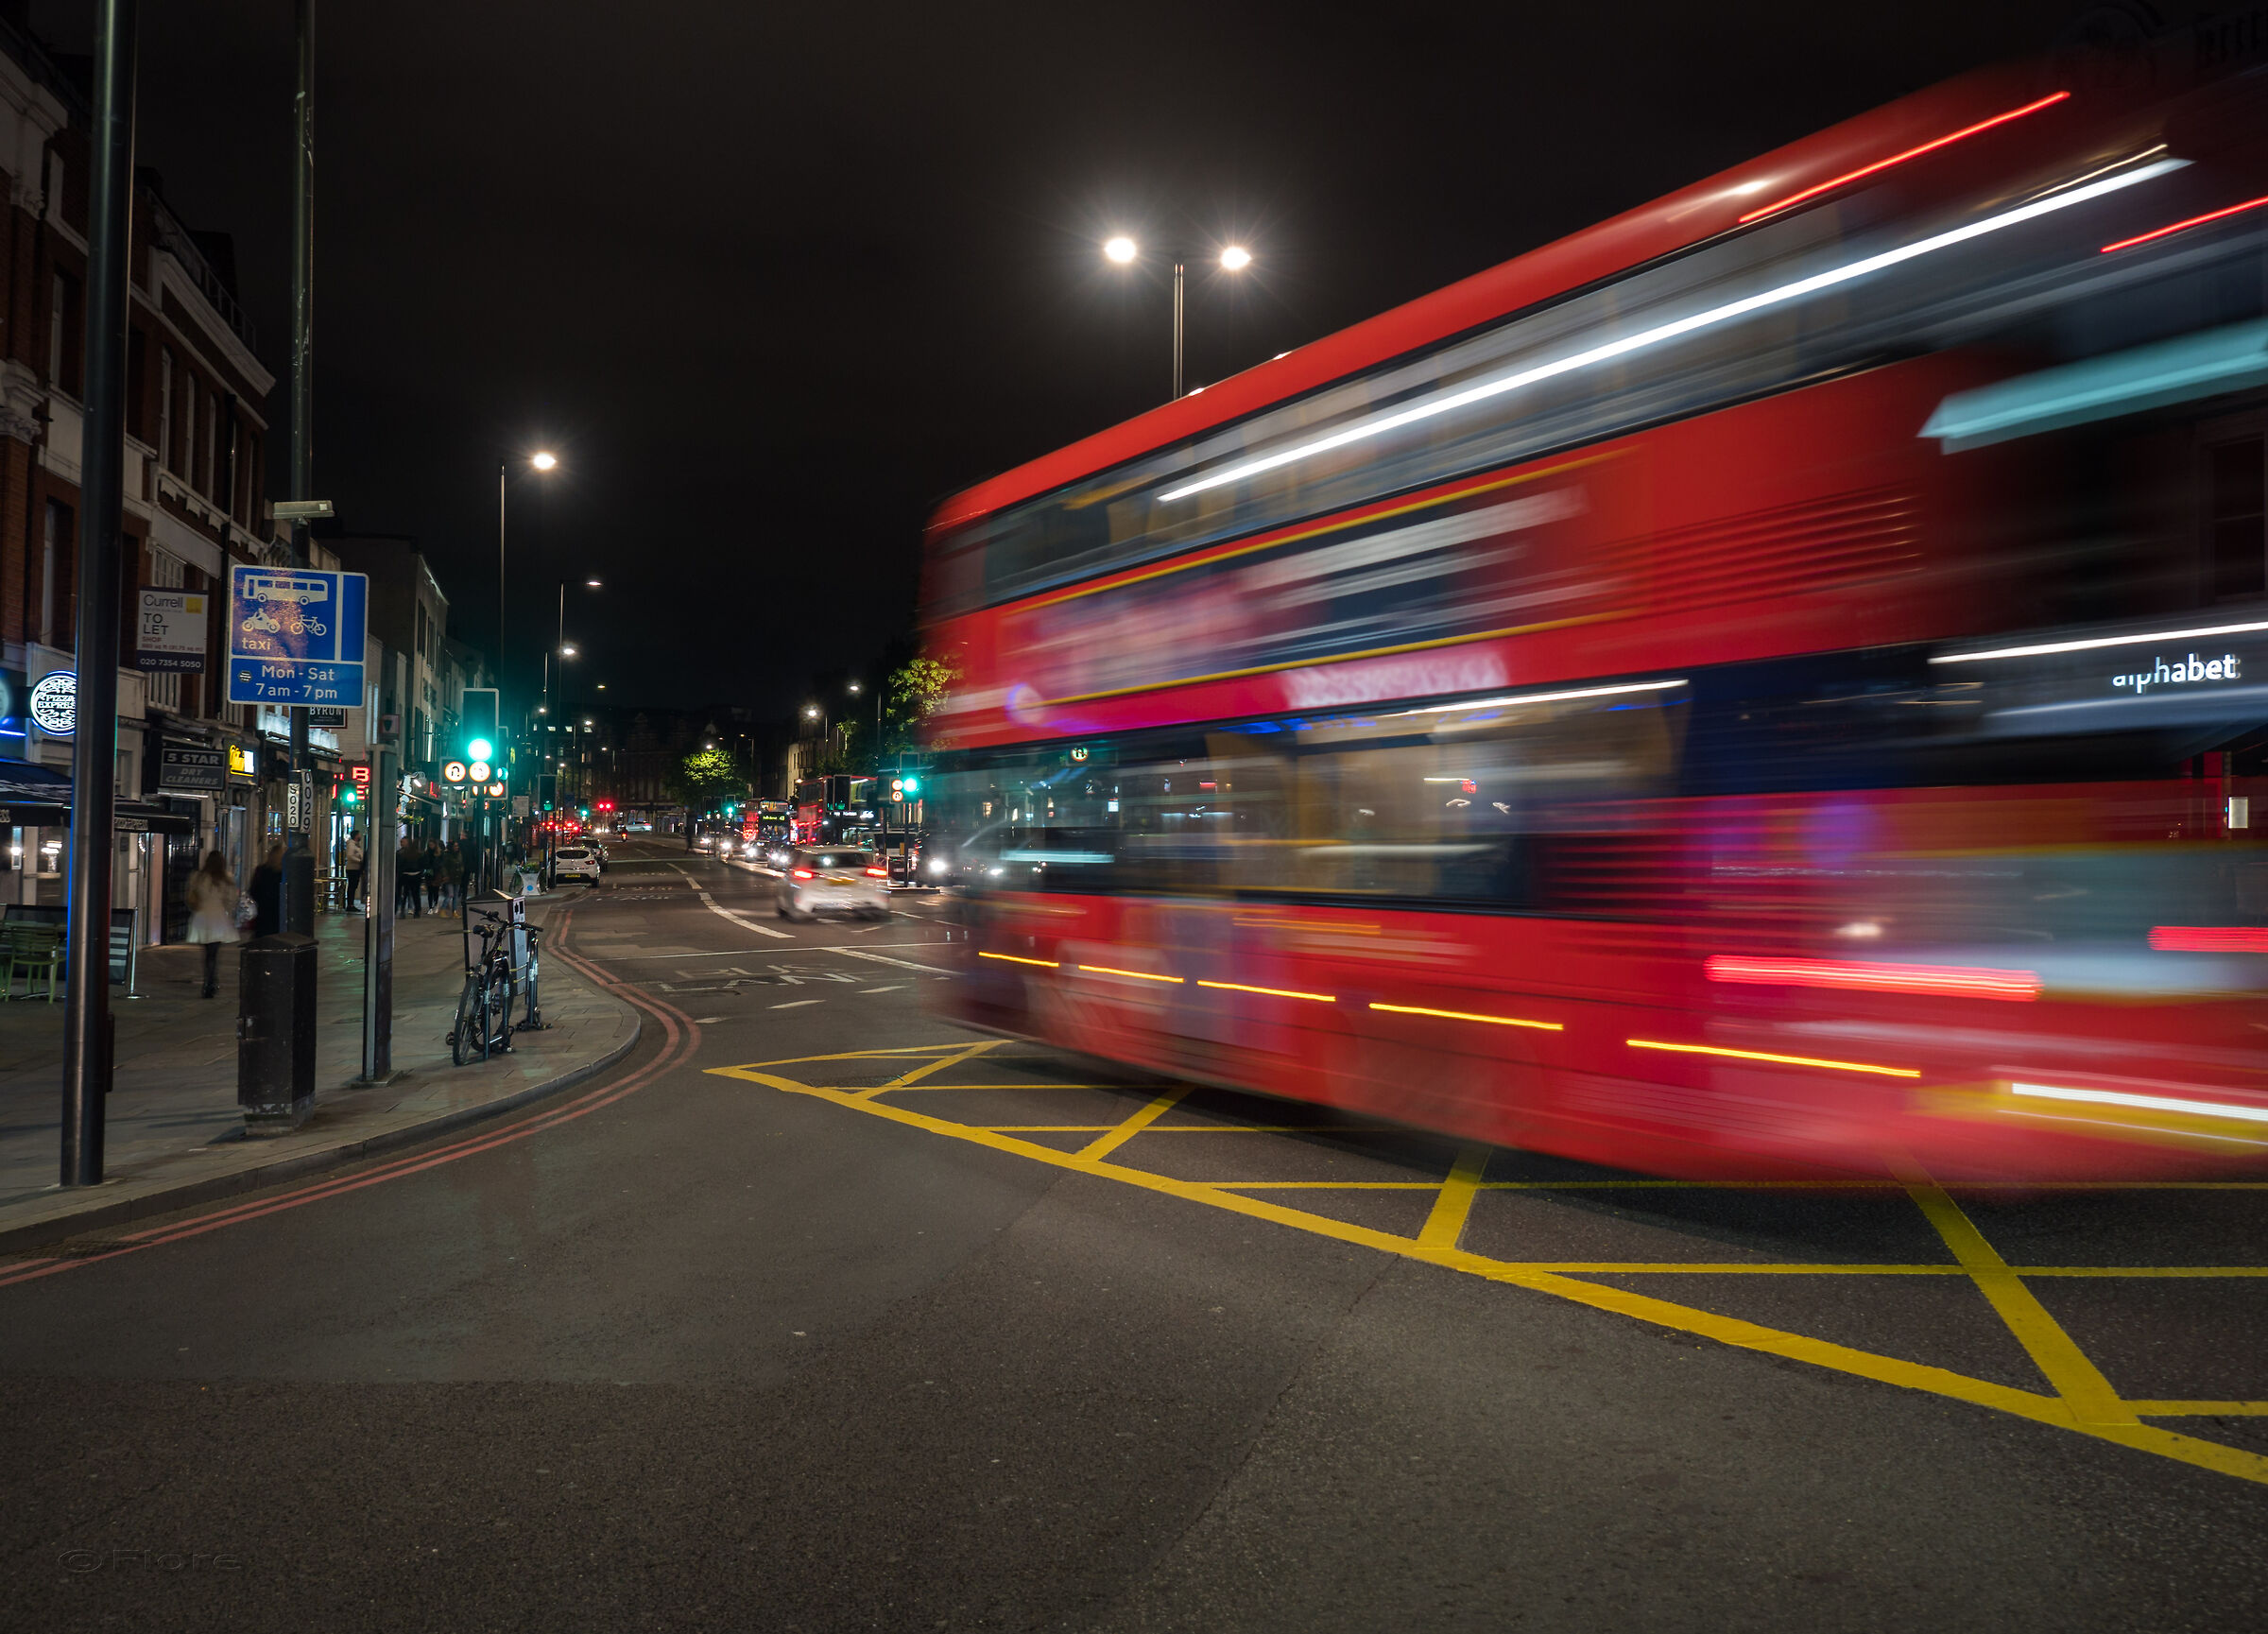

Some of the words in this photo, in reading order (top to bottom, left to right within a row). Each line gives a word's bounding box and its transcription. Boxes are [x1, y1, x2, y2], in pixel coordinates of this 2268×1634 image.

[144, 594, 183, 609] Currell
[144, 613, 163, 624] TO
[144, 624, 168, 635] LET
[241, 636, 271, 651] taxi
[262, 664, 295, 679] Mon
[308, 667, 335, 681] Sat
[166, 752, 178, 763] 5
[181, 753, 220, 765] STAR
[180, 767, 204, 776] DRY
[165, 775, 218, 785] CLEANERS
